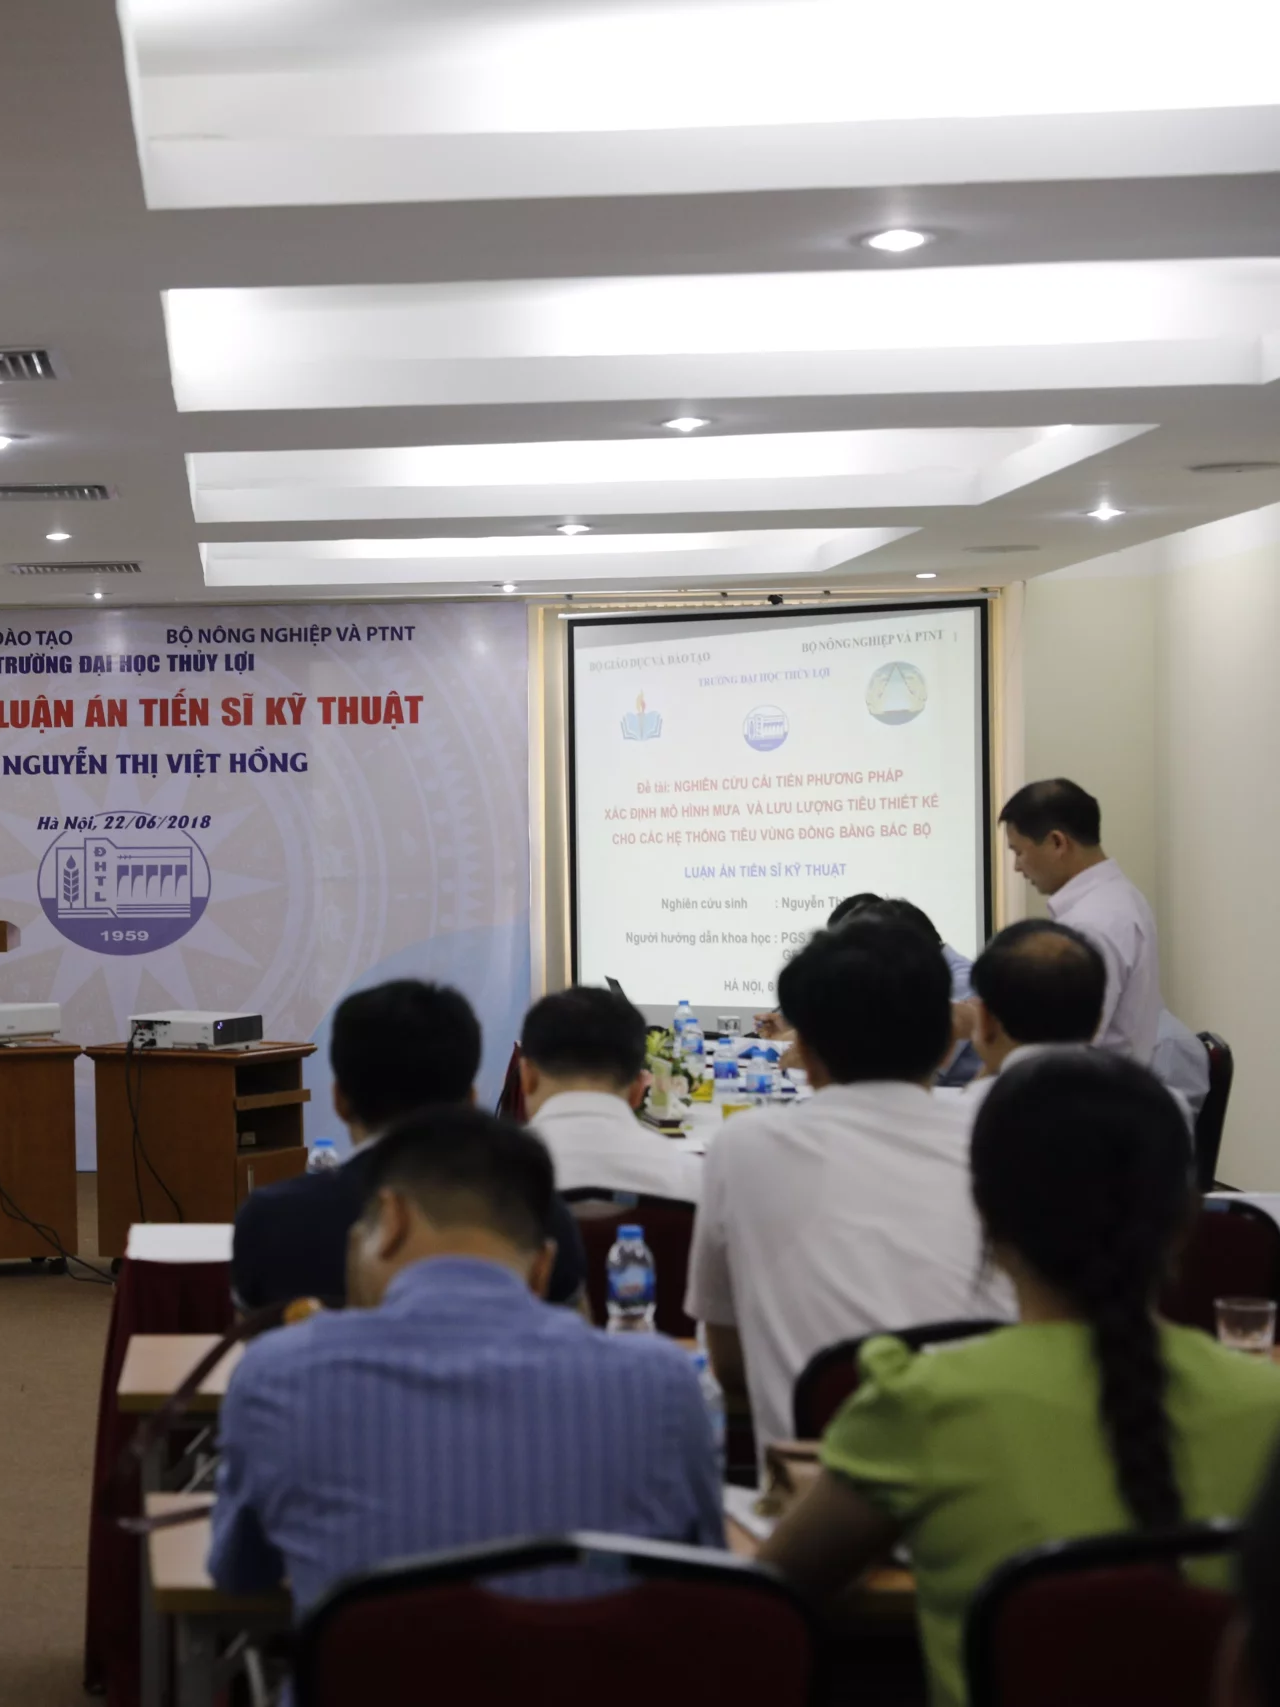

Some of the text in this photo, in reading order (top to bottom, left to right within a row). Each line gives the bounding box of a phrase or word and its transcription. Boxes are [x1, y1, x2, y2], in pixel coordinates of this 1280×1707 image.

[35, 630, 73, 650] TẠO
[166, 623, 416, 648] BỘ NÔNG NGHIỆP VÀ PTNT
[79, 655, 112, 676] ĐẠI
[120, 654, 160, 676] HỌC
[166, 650, 218, 672] THỦY
[224, 651, 255, 674] LỢI
[85, 694, 128, 727] ÁN
[139, 688, 209, 727] TIẾN
[221, 692, 254, 727] SĨ
[266, 692, 307, 726] KỸ
[317, 690, 424, 730] THUẬT
[3, 746, 108, 776] NGUYỄN
[116, 753, 158, 778] THỊ
[165, 749, 221, 778] VIỆT
[229, 746, 308, 773] HỒNG
[37, 815, 212, 832] Hà Nội, 22/06/2018
[100, 930, 149, 942] 1959
